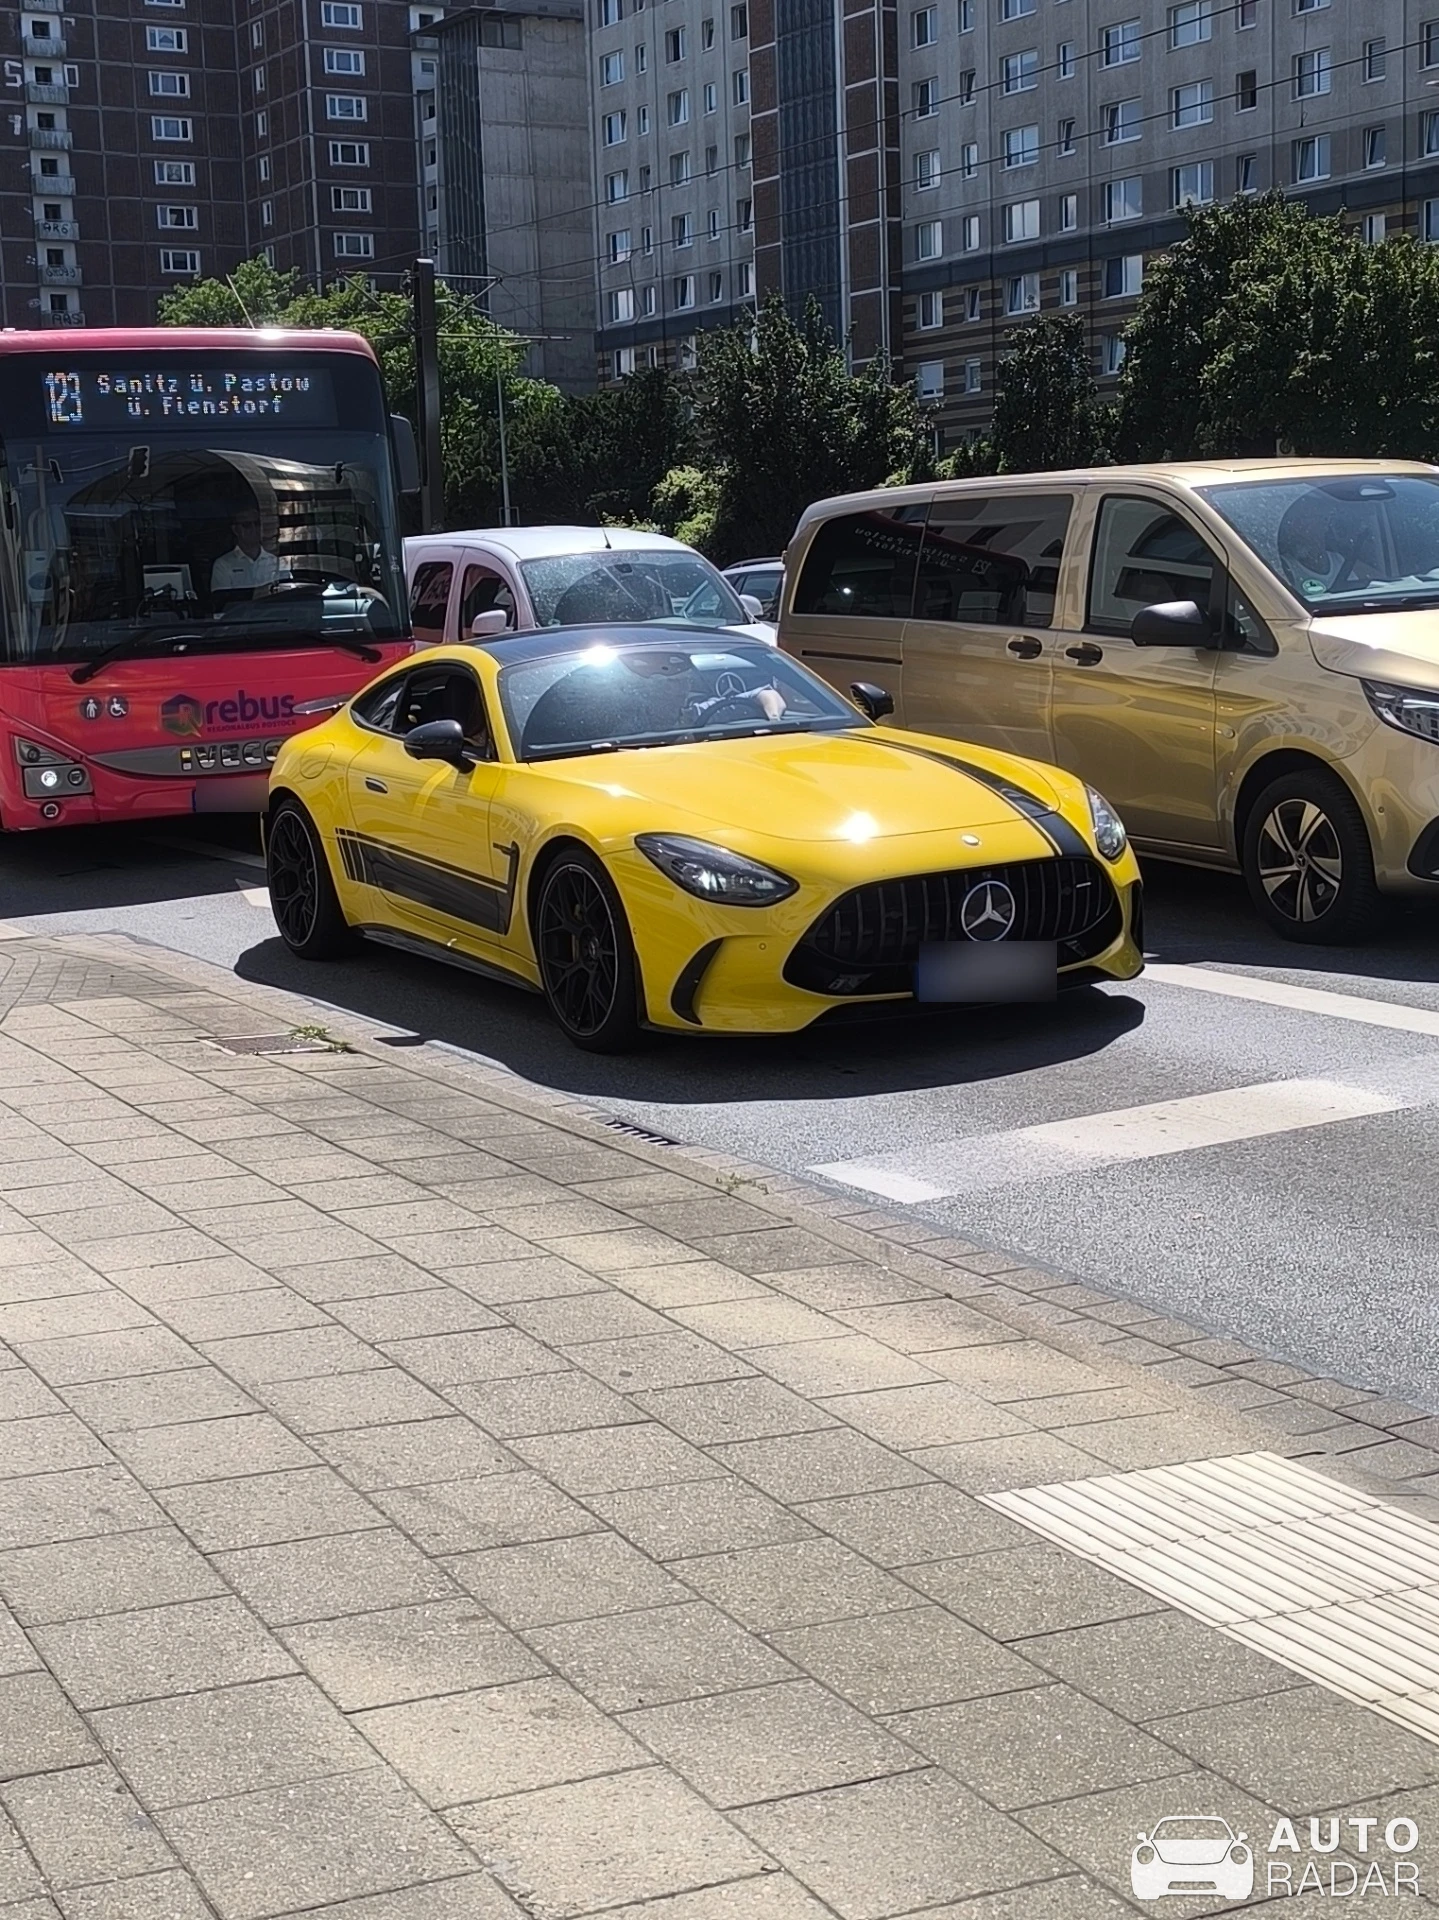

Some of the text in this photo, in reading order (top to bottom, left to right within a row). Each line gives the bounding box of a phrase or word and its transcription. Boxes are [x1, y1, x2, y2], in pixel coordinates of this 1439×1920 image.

[45, 372, 83, 422] 123
[97, 373, 310, 394] Sanitz ü. Pastow
[127, 395, 283, 416] ü. Fienstorf
[205, 690, 295, 724] rebus
